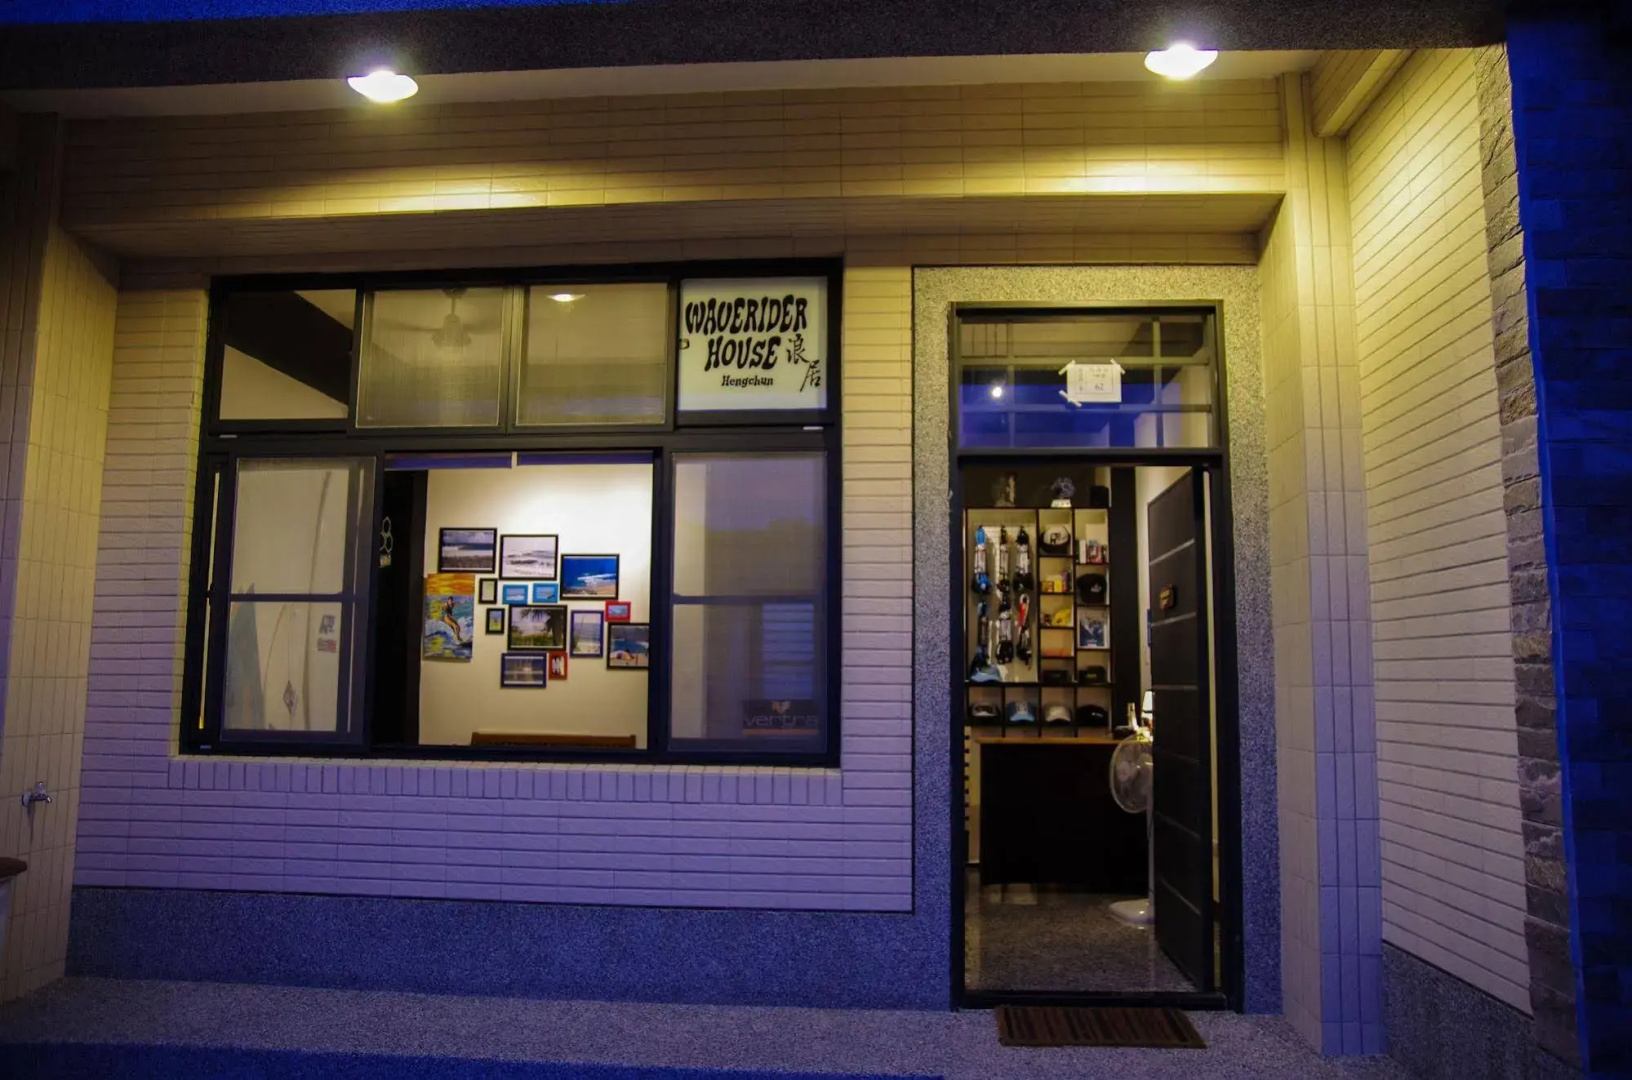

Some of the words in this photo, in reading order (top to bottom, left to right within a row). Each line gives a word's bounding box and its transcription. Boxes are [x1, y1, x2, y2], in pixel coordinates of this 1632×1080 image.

[685, 294, 807, 335] WAVERIDER
[704, 335, 782, 372] HOUSE
[721, 375, 774, 388] Hengchun
